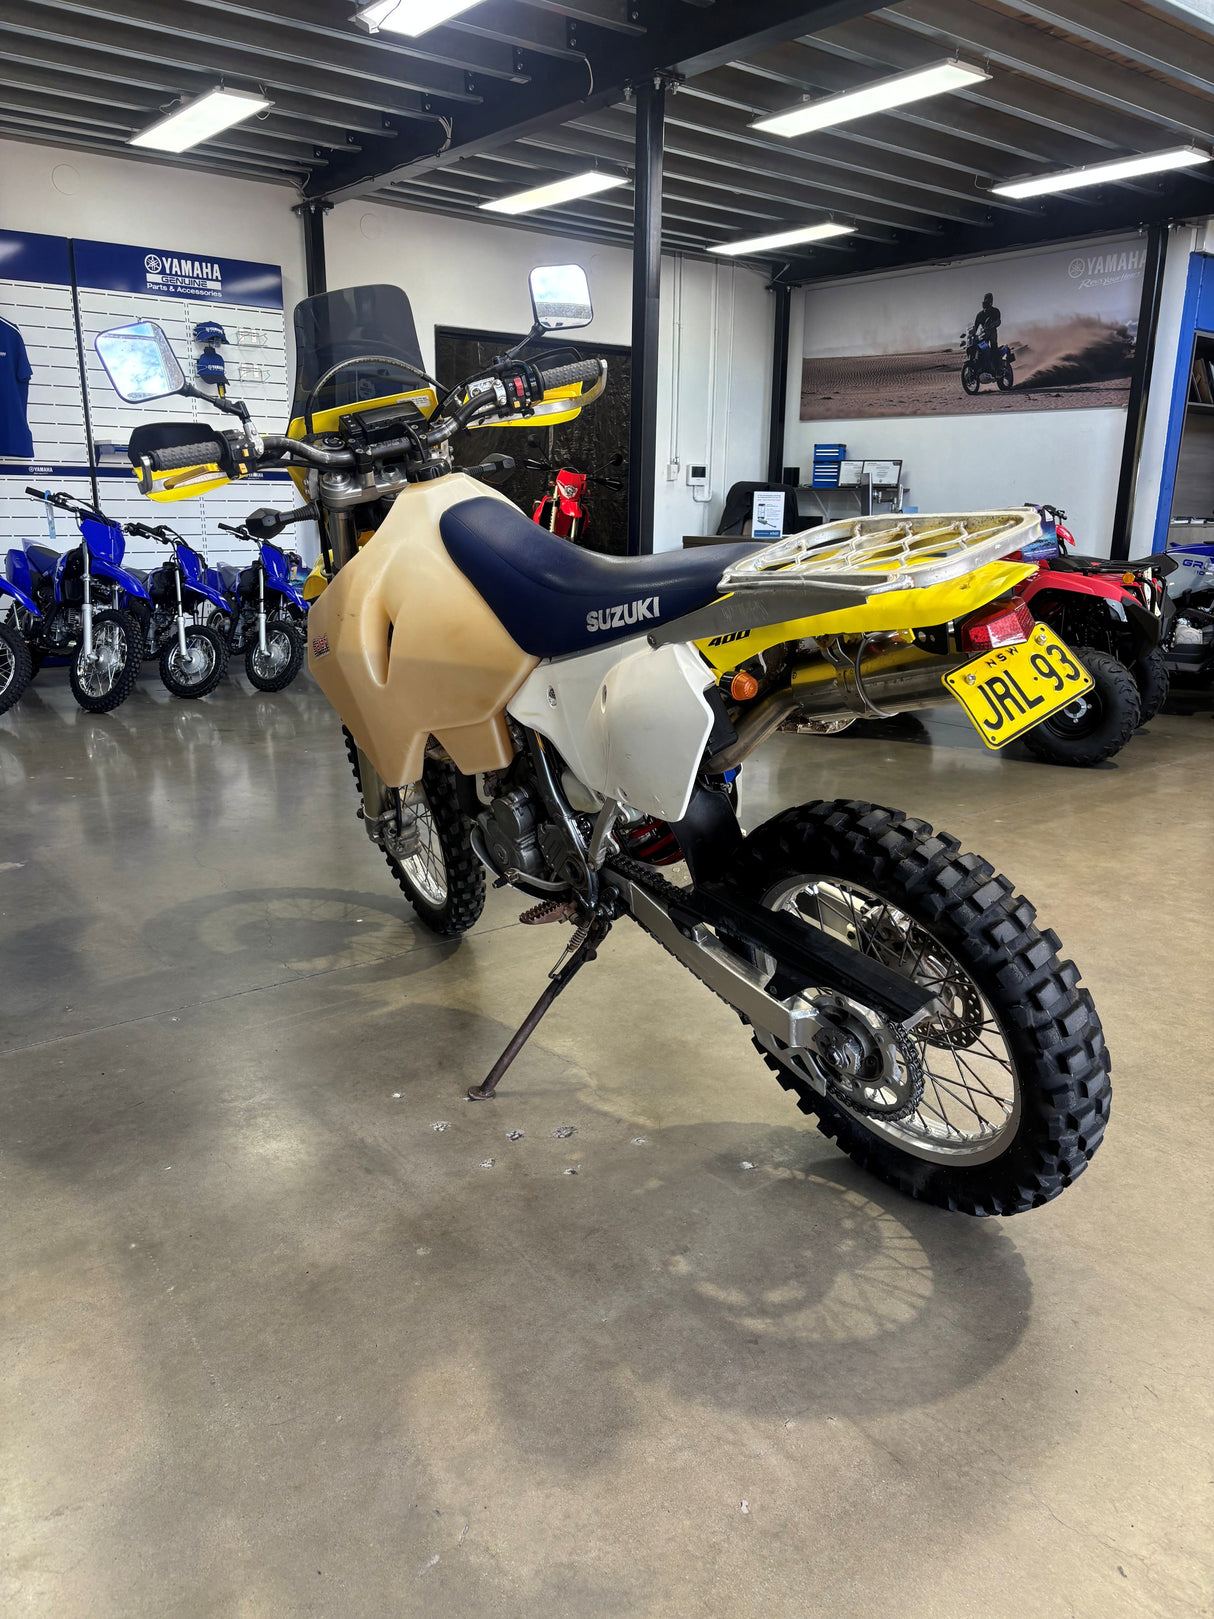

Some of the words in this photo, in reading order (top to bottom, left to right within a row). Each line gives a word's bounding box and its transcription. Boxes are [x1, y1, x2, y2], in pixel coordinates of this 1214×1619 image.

[162, 257, 222, 280] YAMAHA
[146, 282, 168, 291] Parts
[177, 286, 222, 298] Accessories
[161, 276, 207, 288] GENUINE
[586, 596, 661, 633] SUZUKI
[708, 629, 751, 647] 400
[986, 646, 1019, 668] NSW
